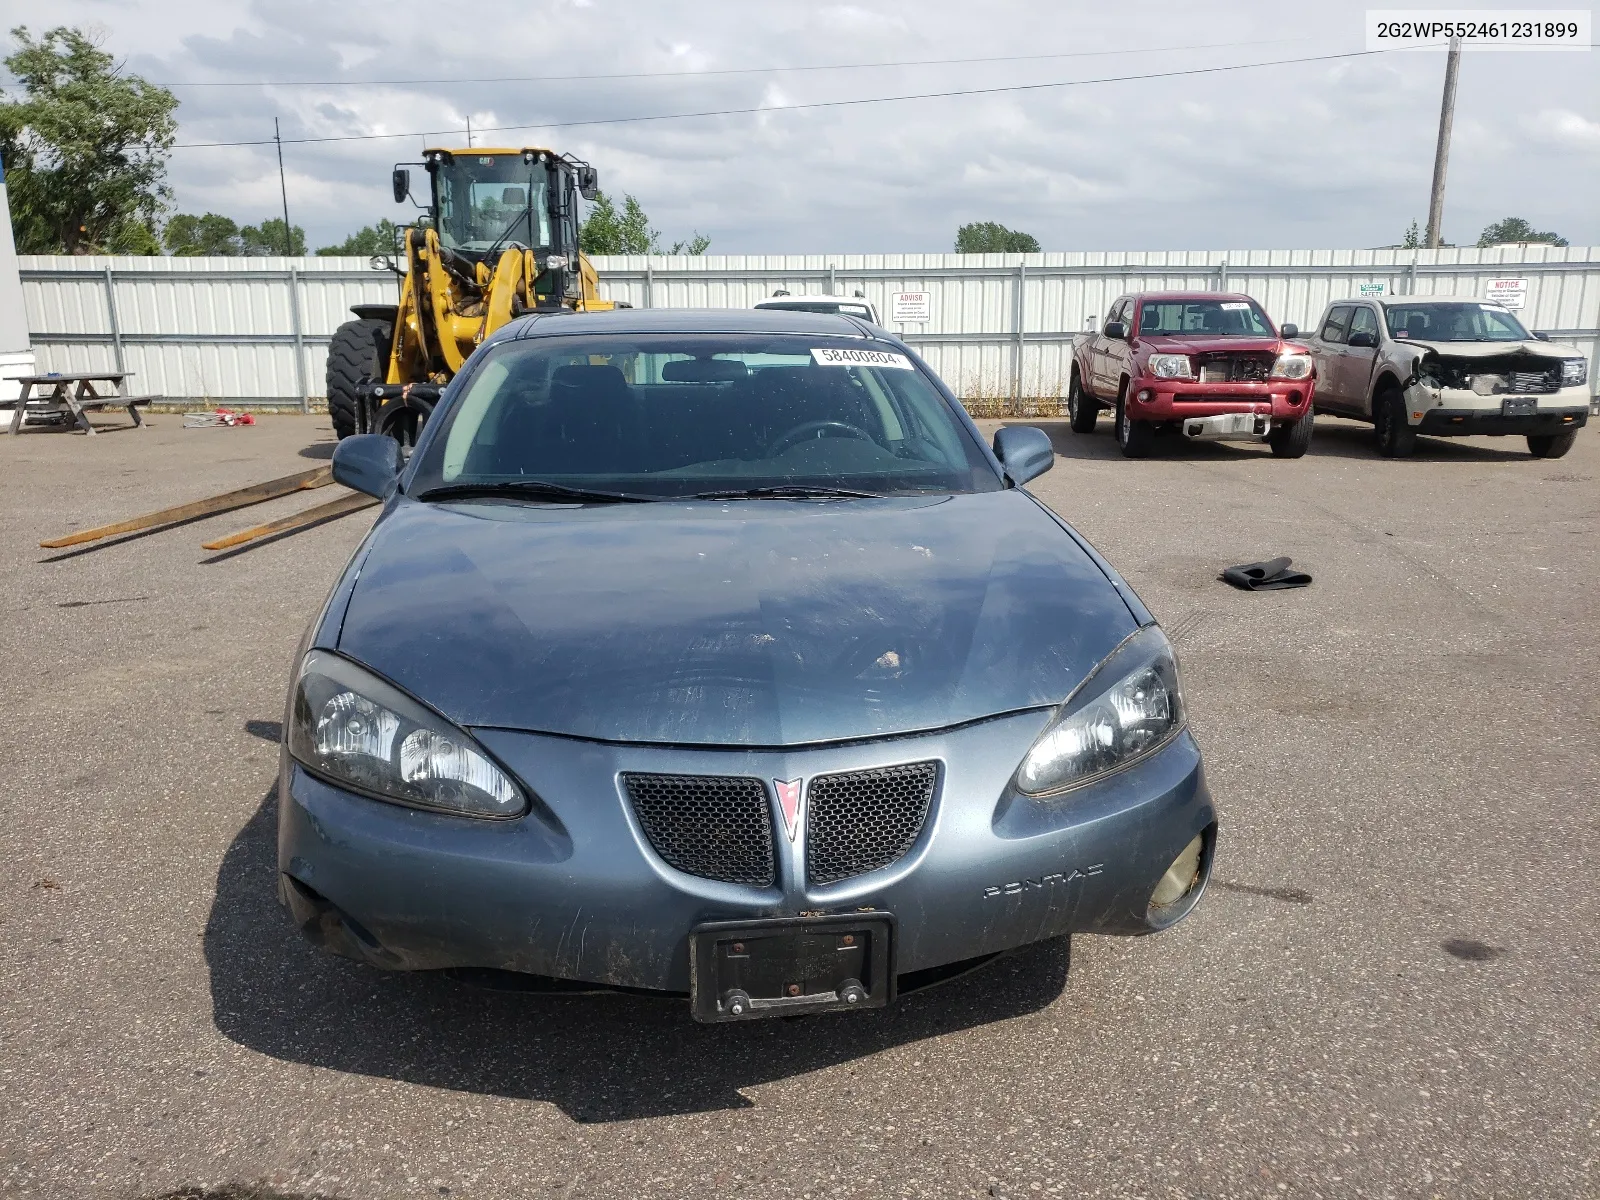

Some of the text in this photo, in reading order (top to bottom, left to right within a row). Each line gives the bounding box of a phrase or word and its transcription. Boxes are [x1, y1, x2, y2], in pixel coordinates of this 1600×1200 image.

[1495, 281, 1520, 289] NOTICE
[900, 294, 923, 302] ADVISO
[821, 349, 897, 365] 58400804
[983, 863, 1104, 899] PONTIAC
